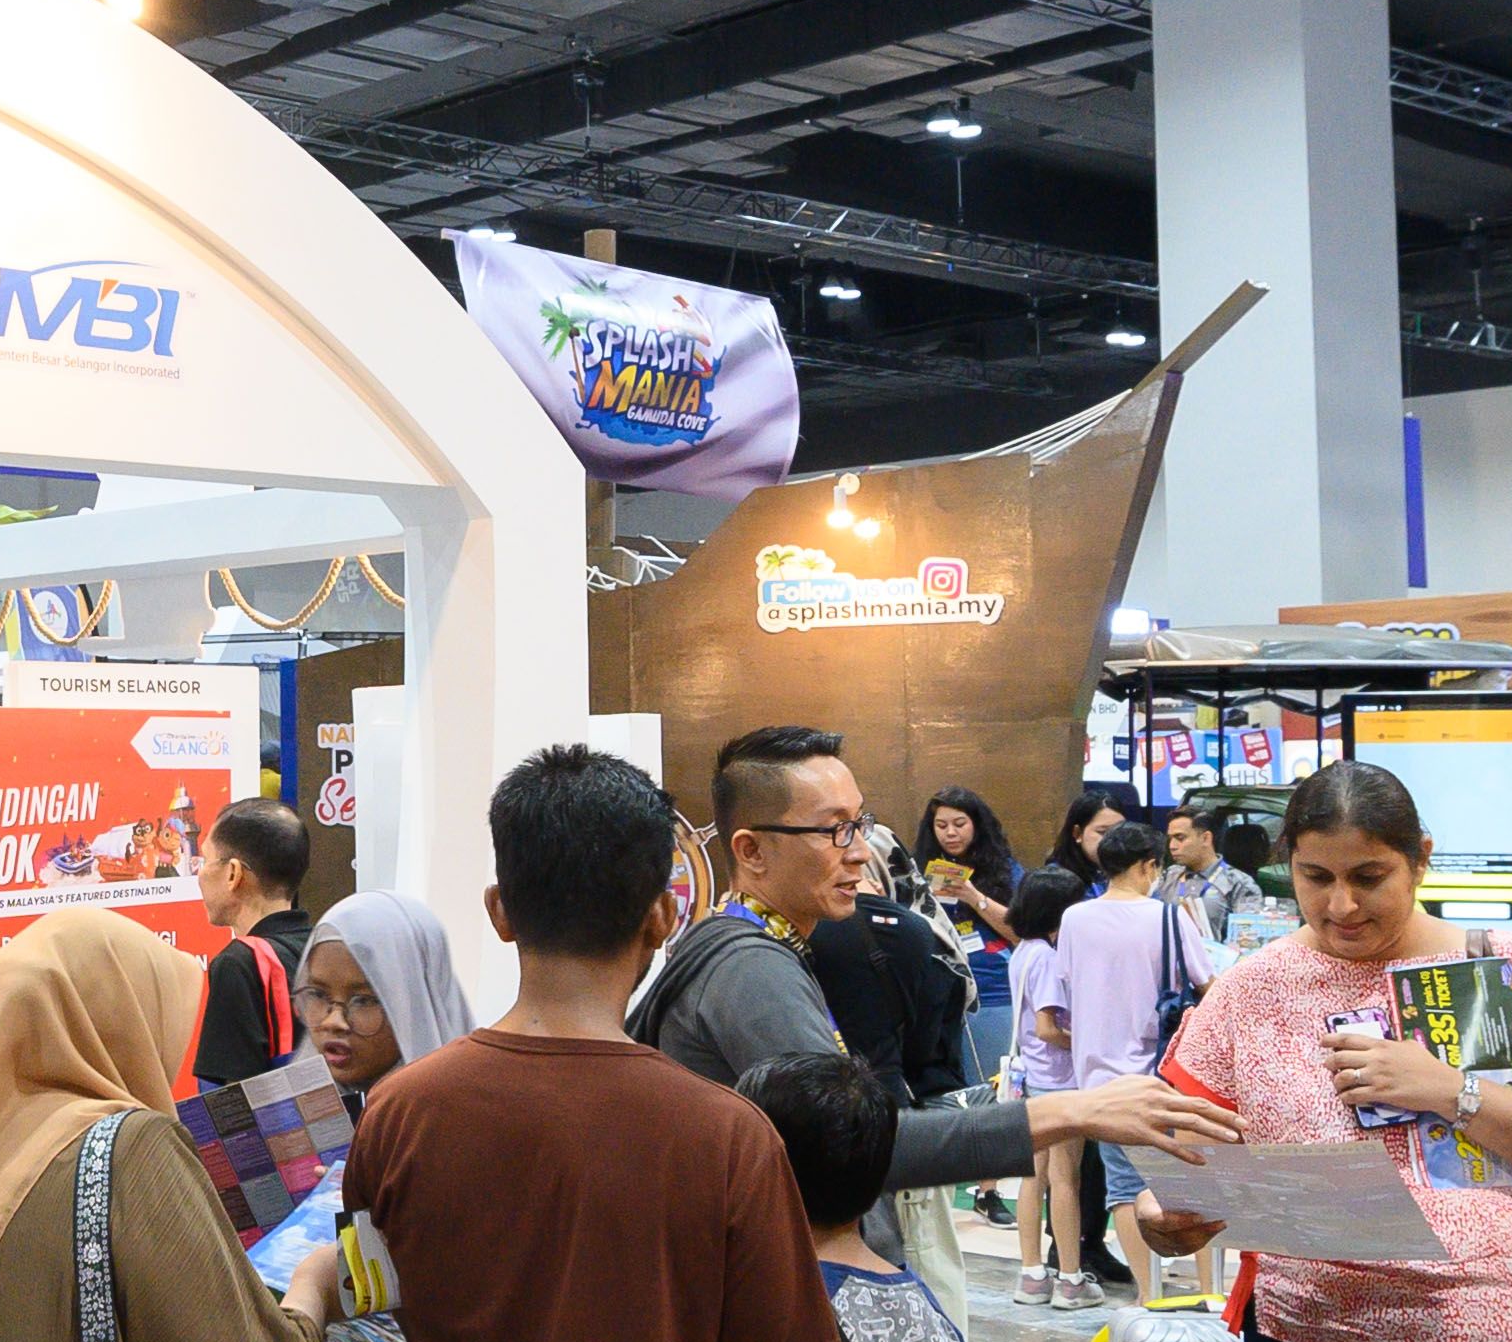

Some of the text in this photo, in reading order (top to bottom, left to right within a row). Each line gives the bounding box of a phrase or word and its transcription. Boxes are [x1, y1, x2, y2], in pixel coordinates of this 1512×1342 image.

[584, 318, 694, 373] SPLASH
[32, 351, 62, 367] Besar
[64, 356, 112, 373] Selangor
[113, 360, 181, 380] Incorporated
[587, 360, 701, 414] MANIA
[626, 404, 708, 431] GAMUDA COVE
[770, 582, 848, 603] Follow
[886, 582, 916, 597] on
[763, 597, 998, 626] @splashmania.my
[39, 677, 201, 695] TOURISM SELANGOR
[152, 733, 230, 756] SELANGOR
[7, 893, 64, 908] MALAYSIA'S
[65, 890, 111, 903] FEATURED
[112, 885, 172, 900] DESTINATION
[1432, 967, 1452, 1009] TICKET
